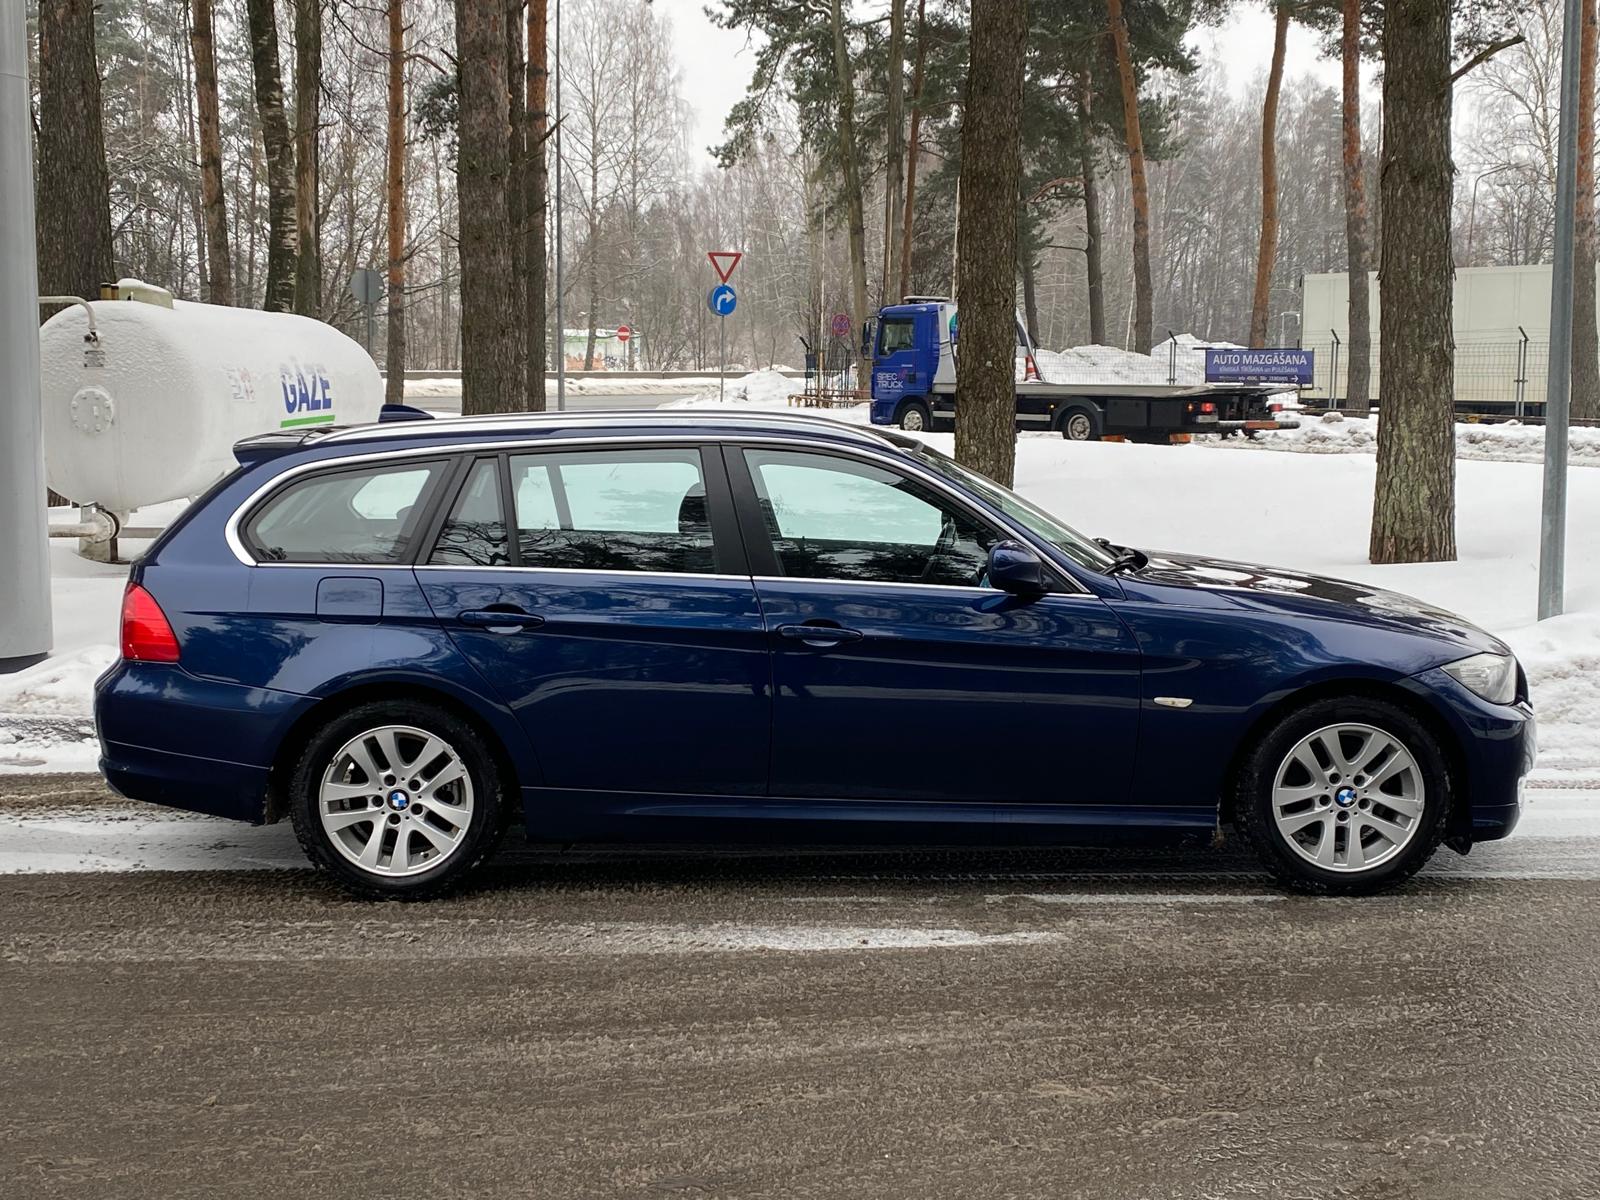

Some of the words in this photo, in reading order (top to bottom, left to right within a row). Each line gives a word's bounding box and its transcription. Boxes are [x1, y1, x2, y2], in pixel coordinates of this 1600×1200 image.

[1213, 354, 1239, 364] AUTO
[1243, 352, 1307, 364] MAZGĀŠANA
[877, 372, 898, 381] SPEC
